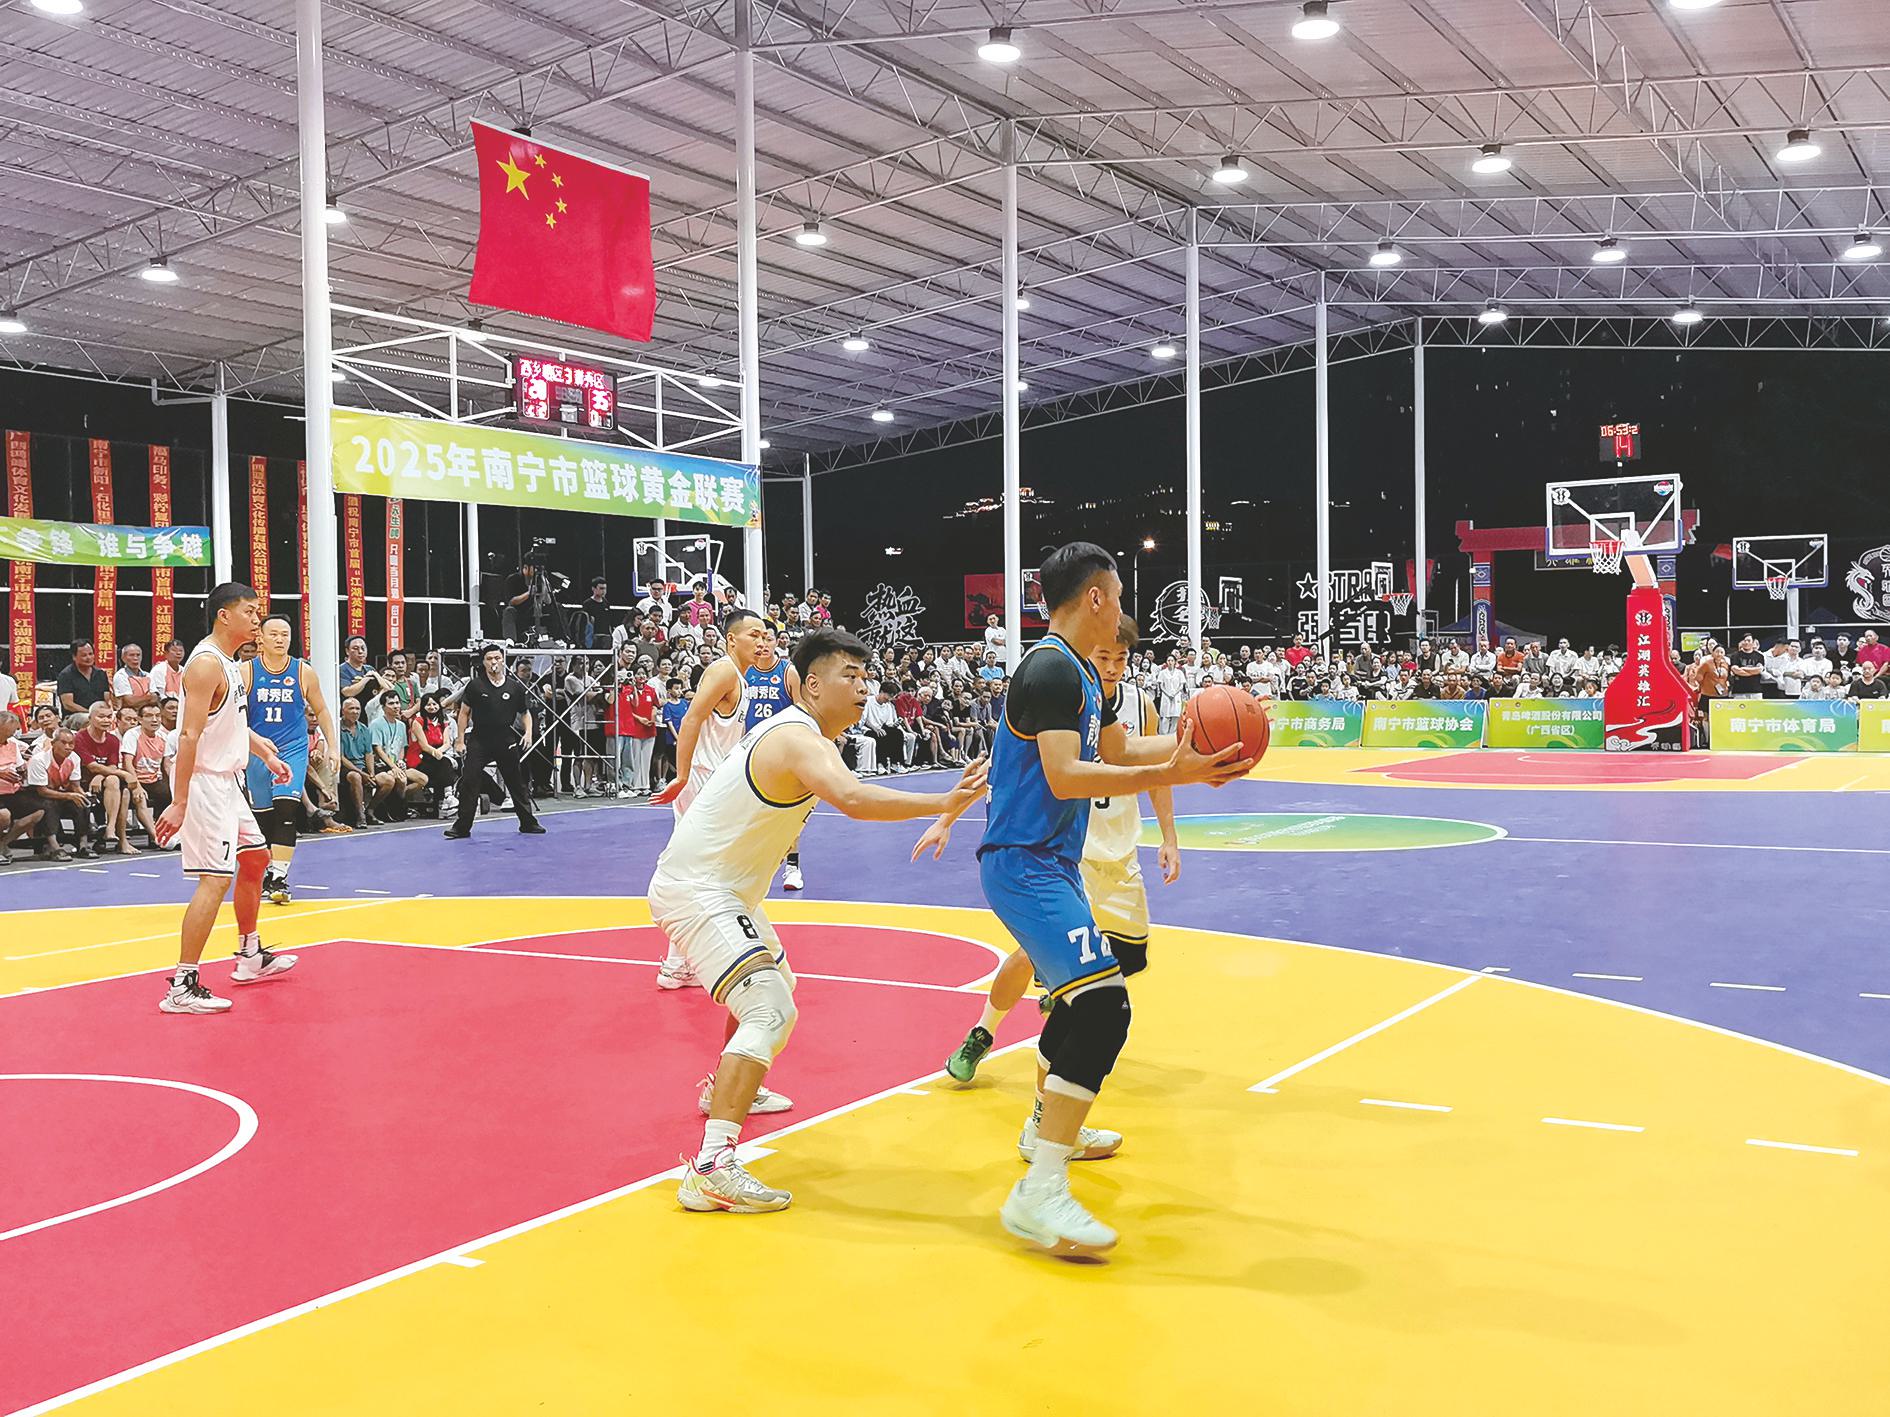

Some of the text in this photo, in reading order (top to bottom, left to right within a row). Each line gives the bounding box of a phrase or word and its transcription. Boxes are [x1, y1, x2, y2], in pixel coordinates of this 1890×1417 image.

[1616, 433, 1632, 458] 14
[351, 434, 746, 516] 2025年南宁市篮球黄金联赛
[97, 532, 204, 560] 谁与争雄
[1635, 633, 1651, 708] 江湖英雄汇
[257, 688, 294, 703] 青秀区
[749, 686, 780, 700] 青秀区
[265, 707, 282, 722] 11
[754, 703, 773, 718] 26
[1502, 711, 1603, 721] 青岛啤酒股份有限公司
[1373, 717, 1474, 732] 南宁市篮球协会
[1730, 717, 1836, 734] 南宁市体育局
[222, 841, 230, 861] 7
[736, 914, 759, 939] 8
